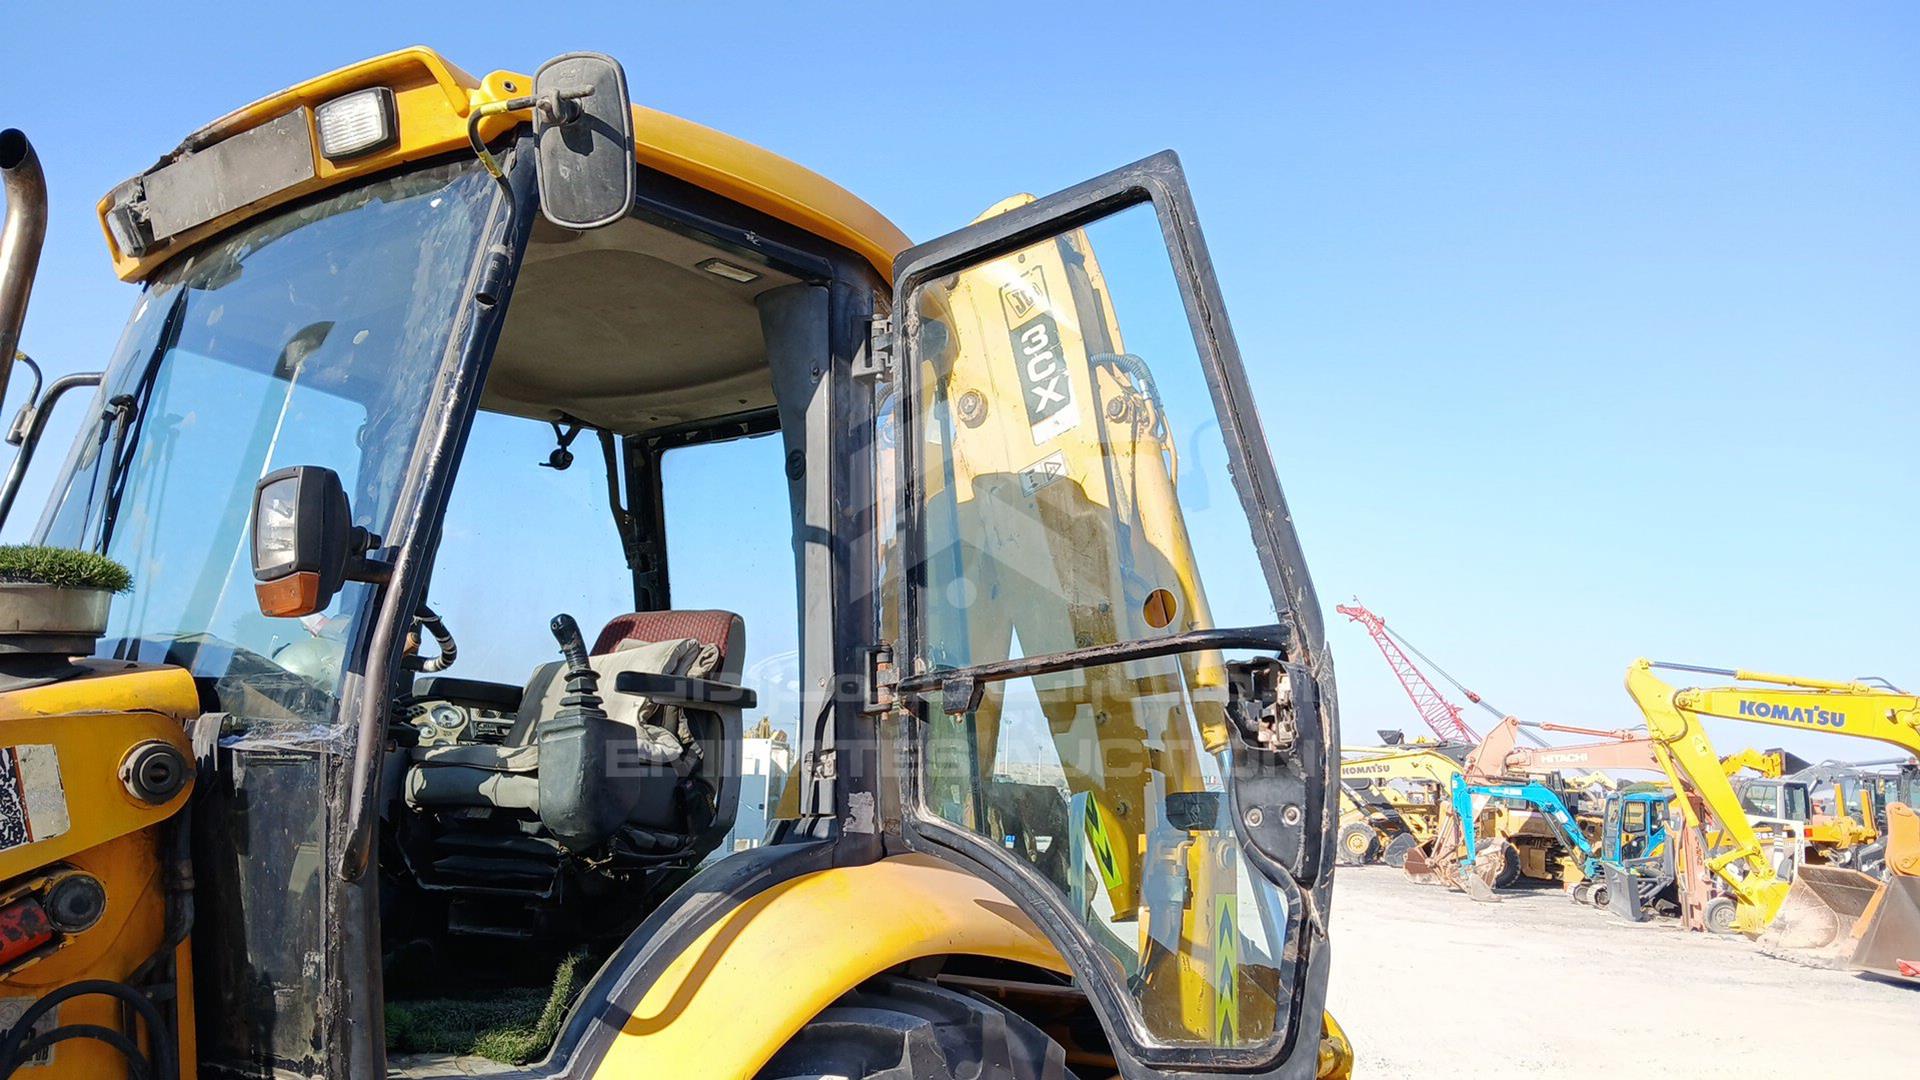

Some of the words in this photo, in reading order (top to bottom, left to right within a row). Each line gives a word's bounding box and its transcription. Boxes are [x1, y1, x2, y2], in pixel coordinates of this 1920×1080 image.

[1012, 284, 1042, 314] JC
[1020, 323, 1066, 414] 3CX
[1739, 700, 1845, 727] KOMATSU
[1342, 763, 1390, 775] KOMATSU
[1541, 752, 1588, 764] HITACHI
